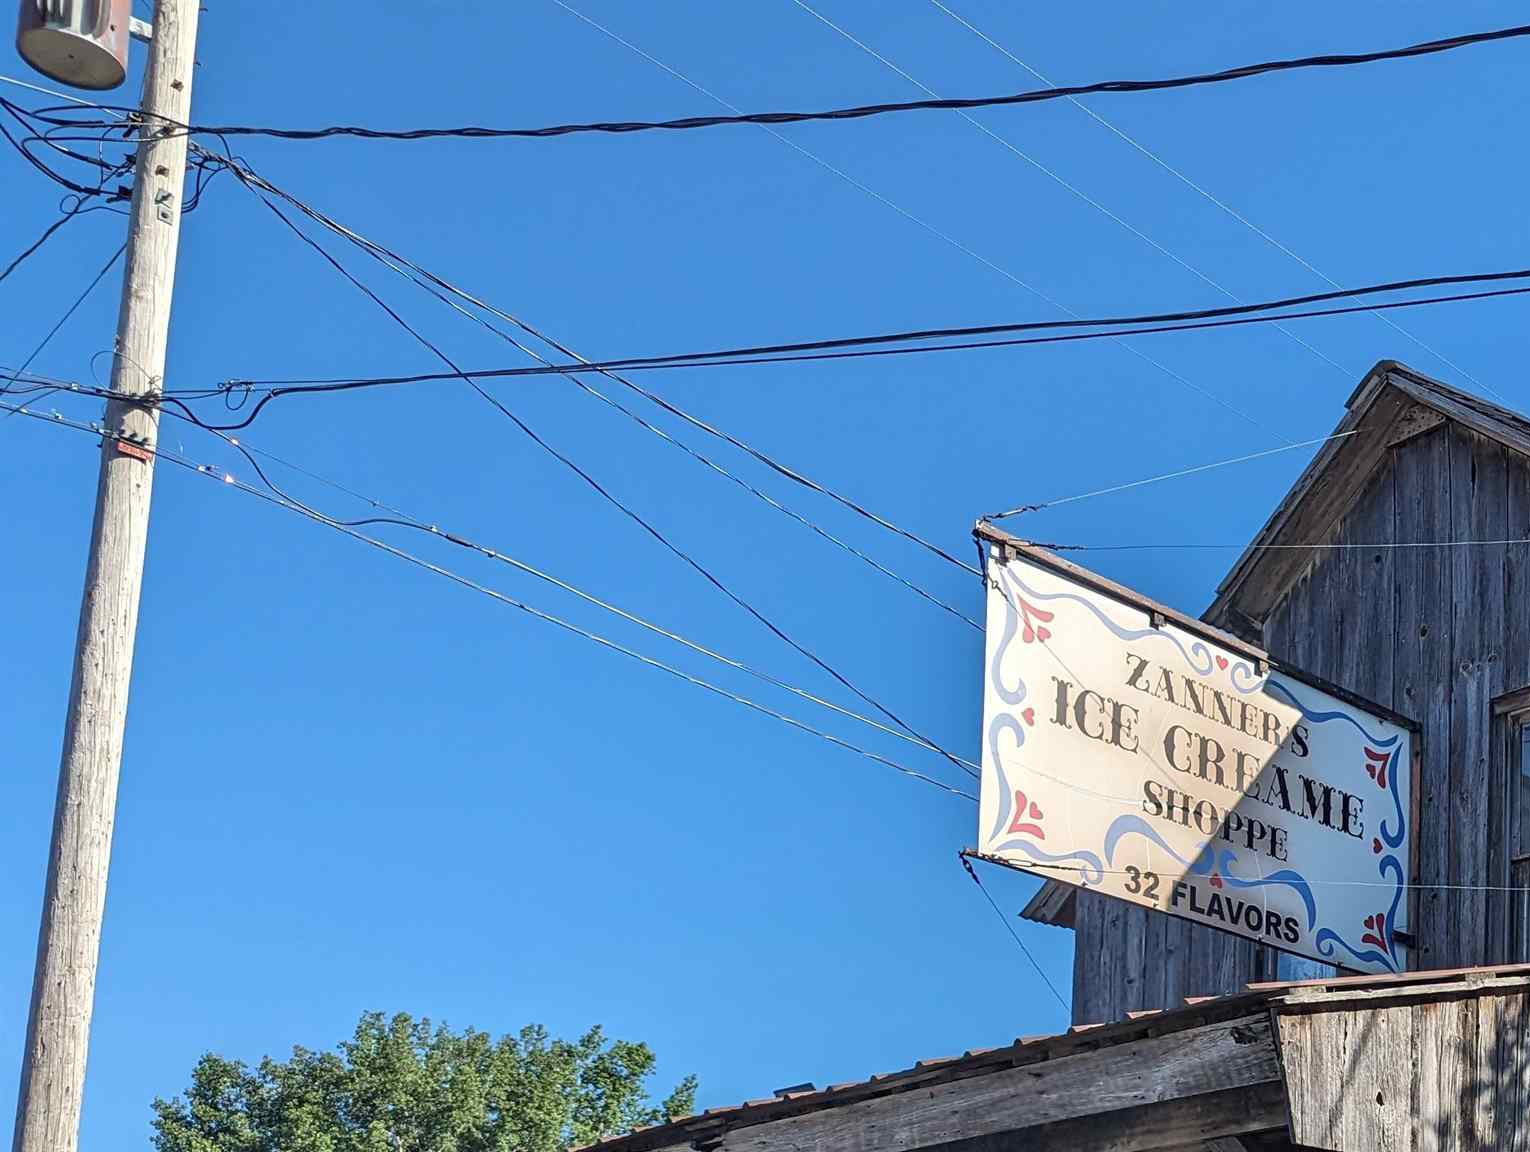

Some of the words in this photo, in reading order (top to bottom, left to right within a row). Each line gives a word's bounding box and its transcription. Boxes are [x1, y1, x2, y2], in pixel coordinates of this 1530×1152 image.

[1050, 676, 1140, 755] ICE
[1164, 724, 1365, 840] CREAME
[1143, 779, 1288, 862] SHOPPE
[1124, 864, 1161, 901] 32
[1171, 881, 1300, 944] FLAVORS
